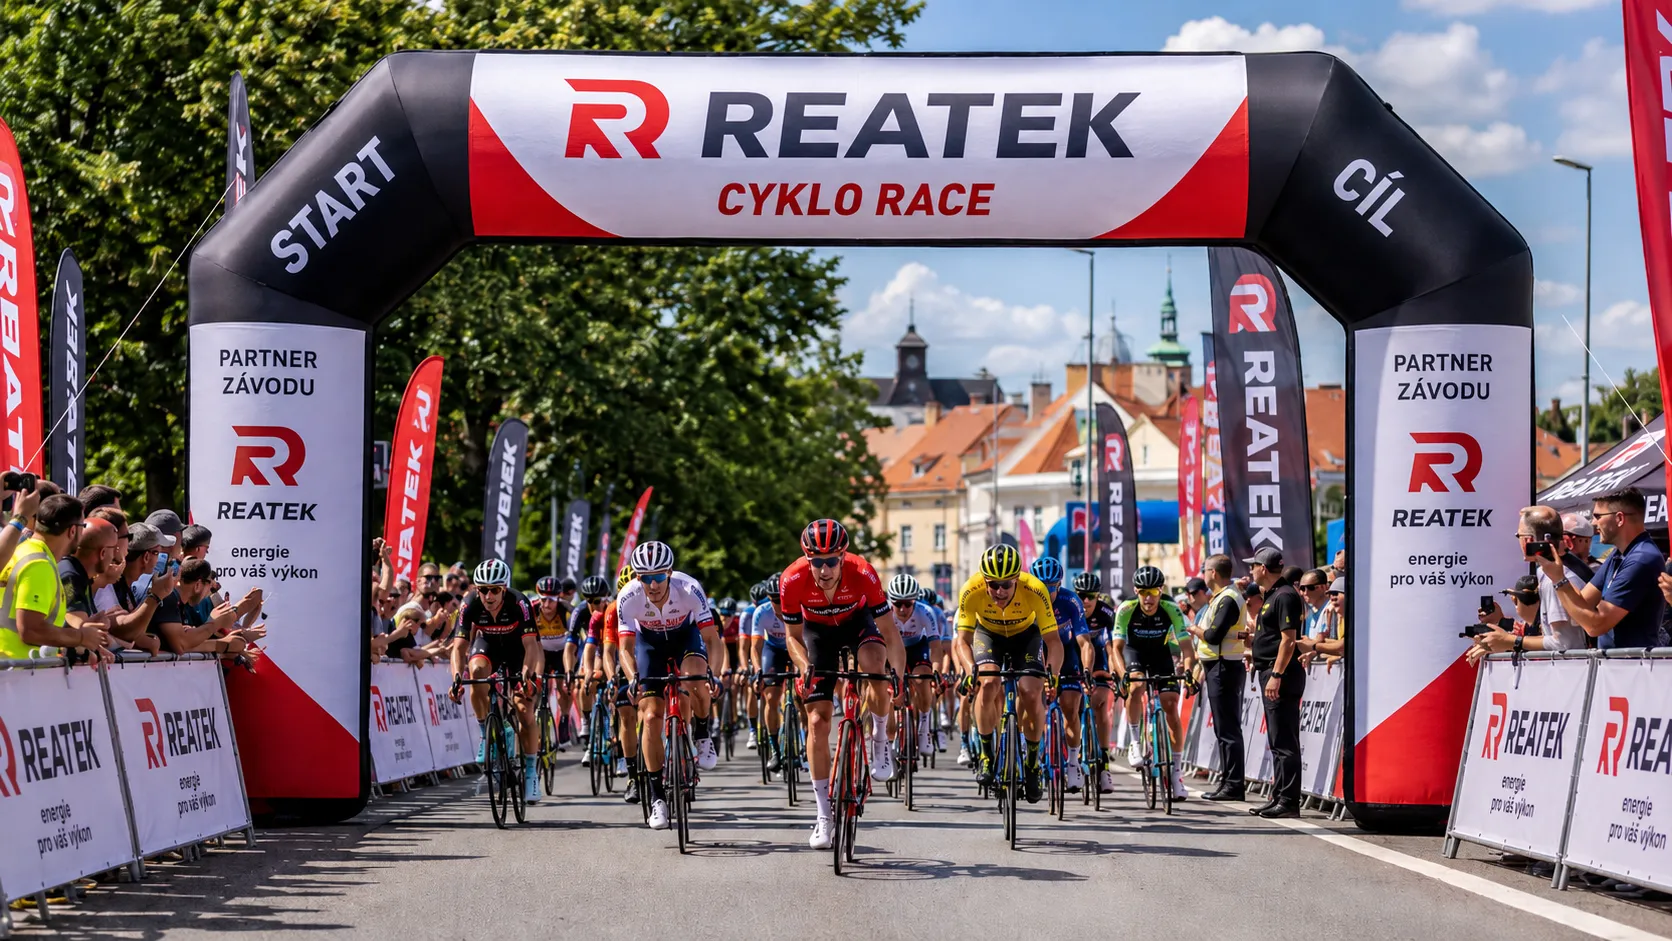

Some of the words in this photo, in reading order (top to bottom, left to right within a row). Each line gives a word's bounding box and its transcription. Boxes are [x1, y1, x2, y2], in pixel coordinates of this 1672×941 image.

[701, 92, 1141, 159] REATEK
[270, 135, 396, 274] START
[717, 182, 863, 217] CYKLO
[875, 182, 996, 217] RACE
[1333, 158, 1406, 238] CÍL
[219, 348, 318, 369] PARTNER
[1394, 353, 1493, 372] PARTNER
[222, 372, 315, 396] ZÁVODU
[1397, 377, 1491, 401] ZÁVODU
[1244, 350, 1284, 551] REATEK
[217, 501, 318, 522] REATEK
[1392, 508, 1493, 528] REATEK
[231, 544, 290, 562] energie
[1408, 551, 1468, 569] energie
[215, 566, 237, 581] pro
[240, 563, 267, 578] váš
[271, 564, 318, 582] výkon
[1390, 574, 1415, 589] pro
[1419, 570, 1446, 586] váš
[1450, 570, 1494, 589] výkon
[163, 707, 222, 757] REATEK
[1504, 710, 1571, 760] REATEK
[18, 719, 101, 783] REATEK
[40, 798, 71, 824] energie
[1622, 795, 1653, 820] energie
[37, 836, 53, 860] pro
[68, 823, 93, 850] výkon
[1607, 823, 1623, 843] pro
[1640, 825, 1667, 851] výkon
